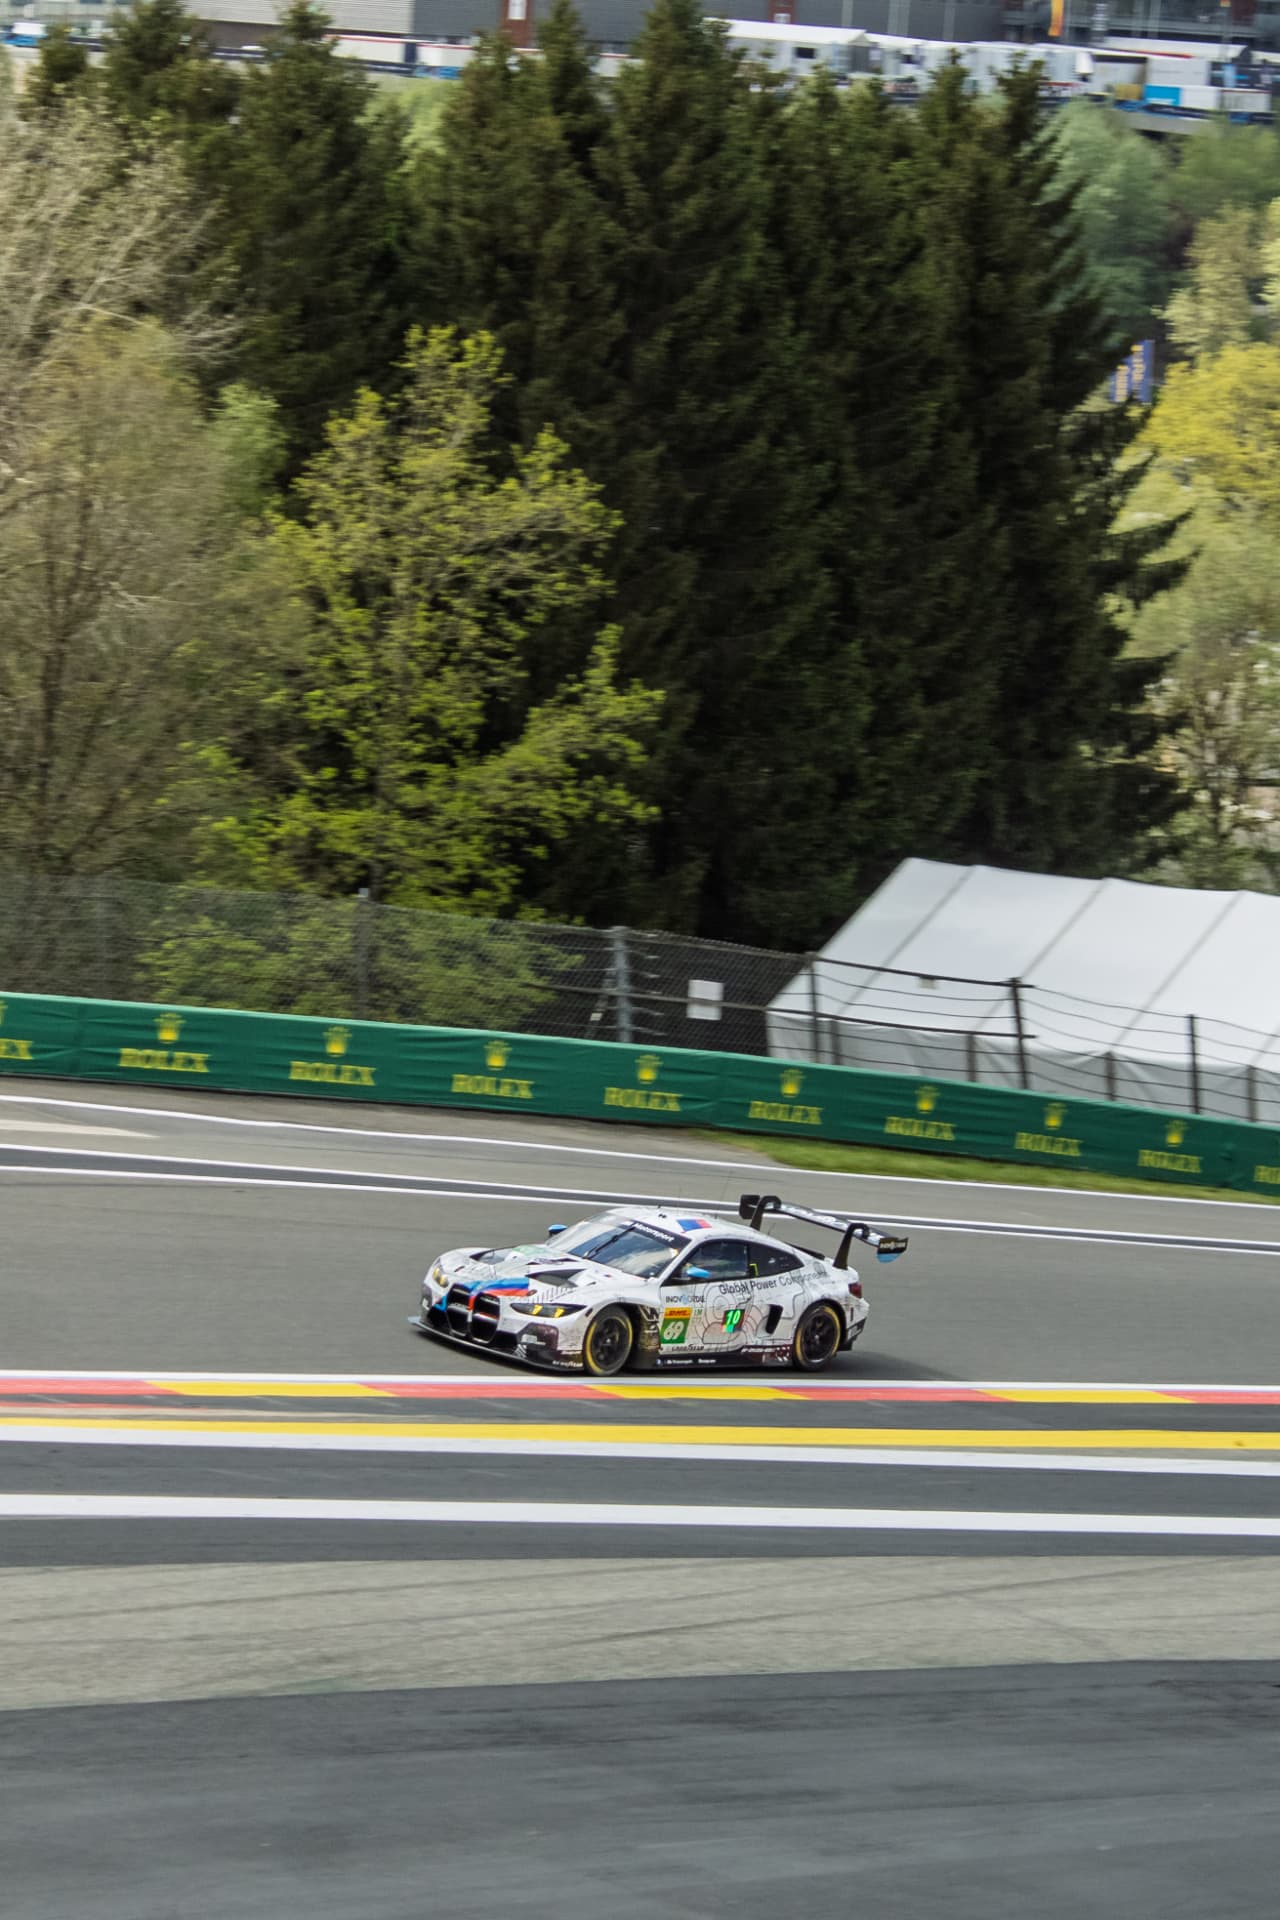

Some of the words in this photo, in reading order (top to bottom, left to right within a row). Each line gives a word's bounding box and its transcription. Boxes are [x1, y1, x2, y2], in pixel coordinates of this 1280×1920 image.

[119, 1047, 210, 1073] ROLEX
[289, 1061, 375, 1086] ROLEX
[453, 1074, 534, 1099] ROLEX
[604, 1087, 682, 1112] ROLEX
[749, 1101, 822, 1125] ROLEX
[885, 1116, 955, 1141] ROLEX
[1015, 1131, 1082, 1157] ROLEX
[1139, 1150, 1203, 1174] ROLEX
[719, 1281, 749, 1295] Global
[750, 1279, 777, 1292] Power
[725, 1309, 741, 1326] 10
[663, 1321, 685, 1341] 69
